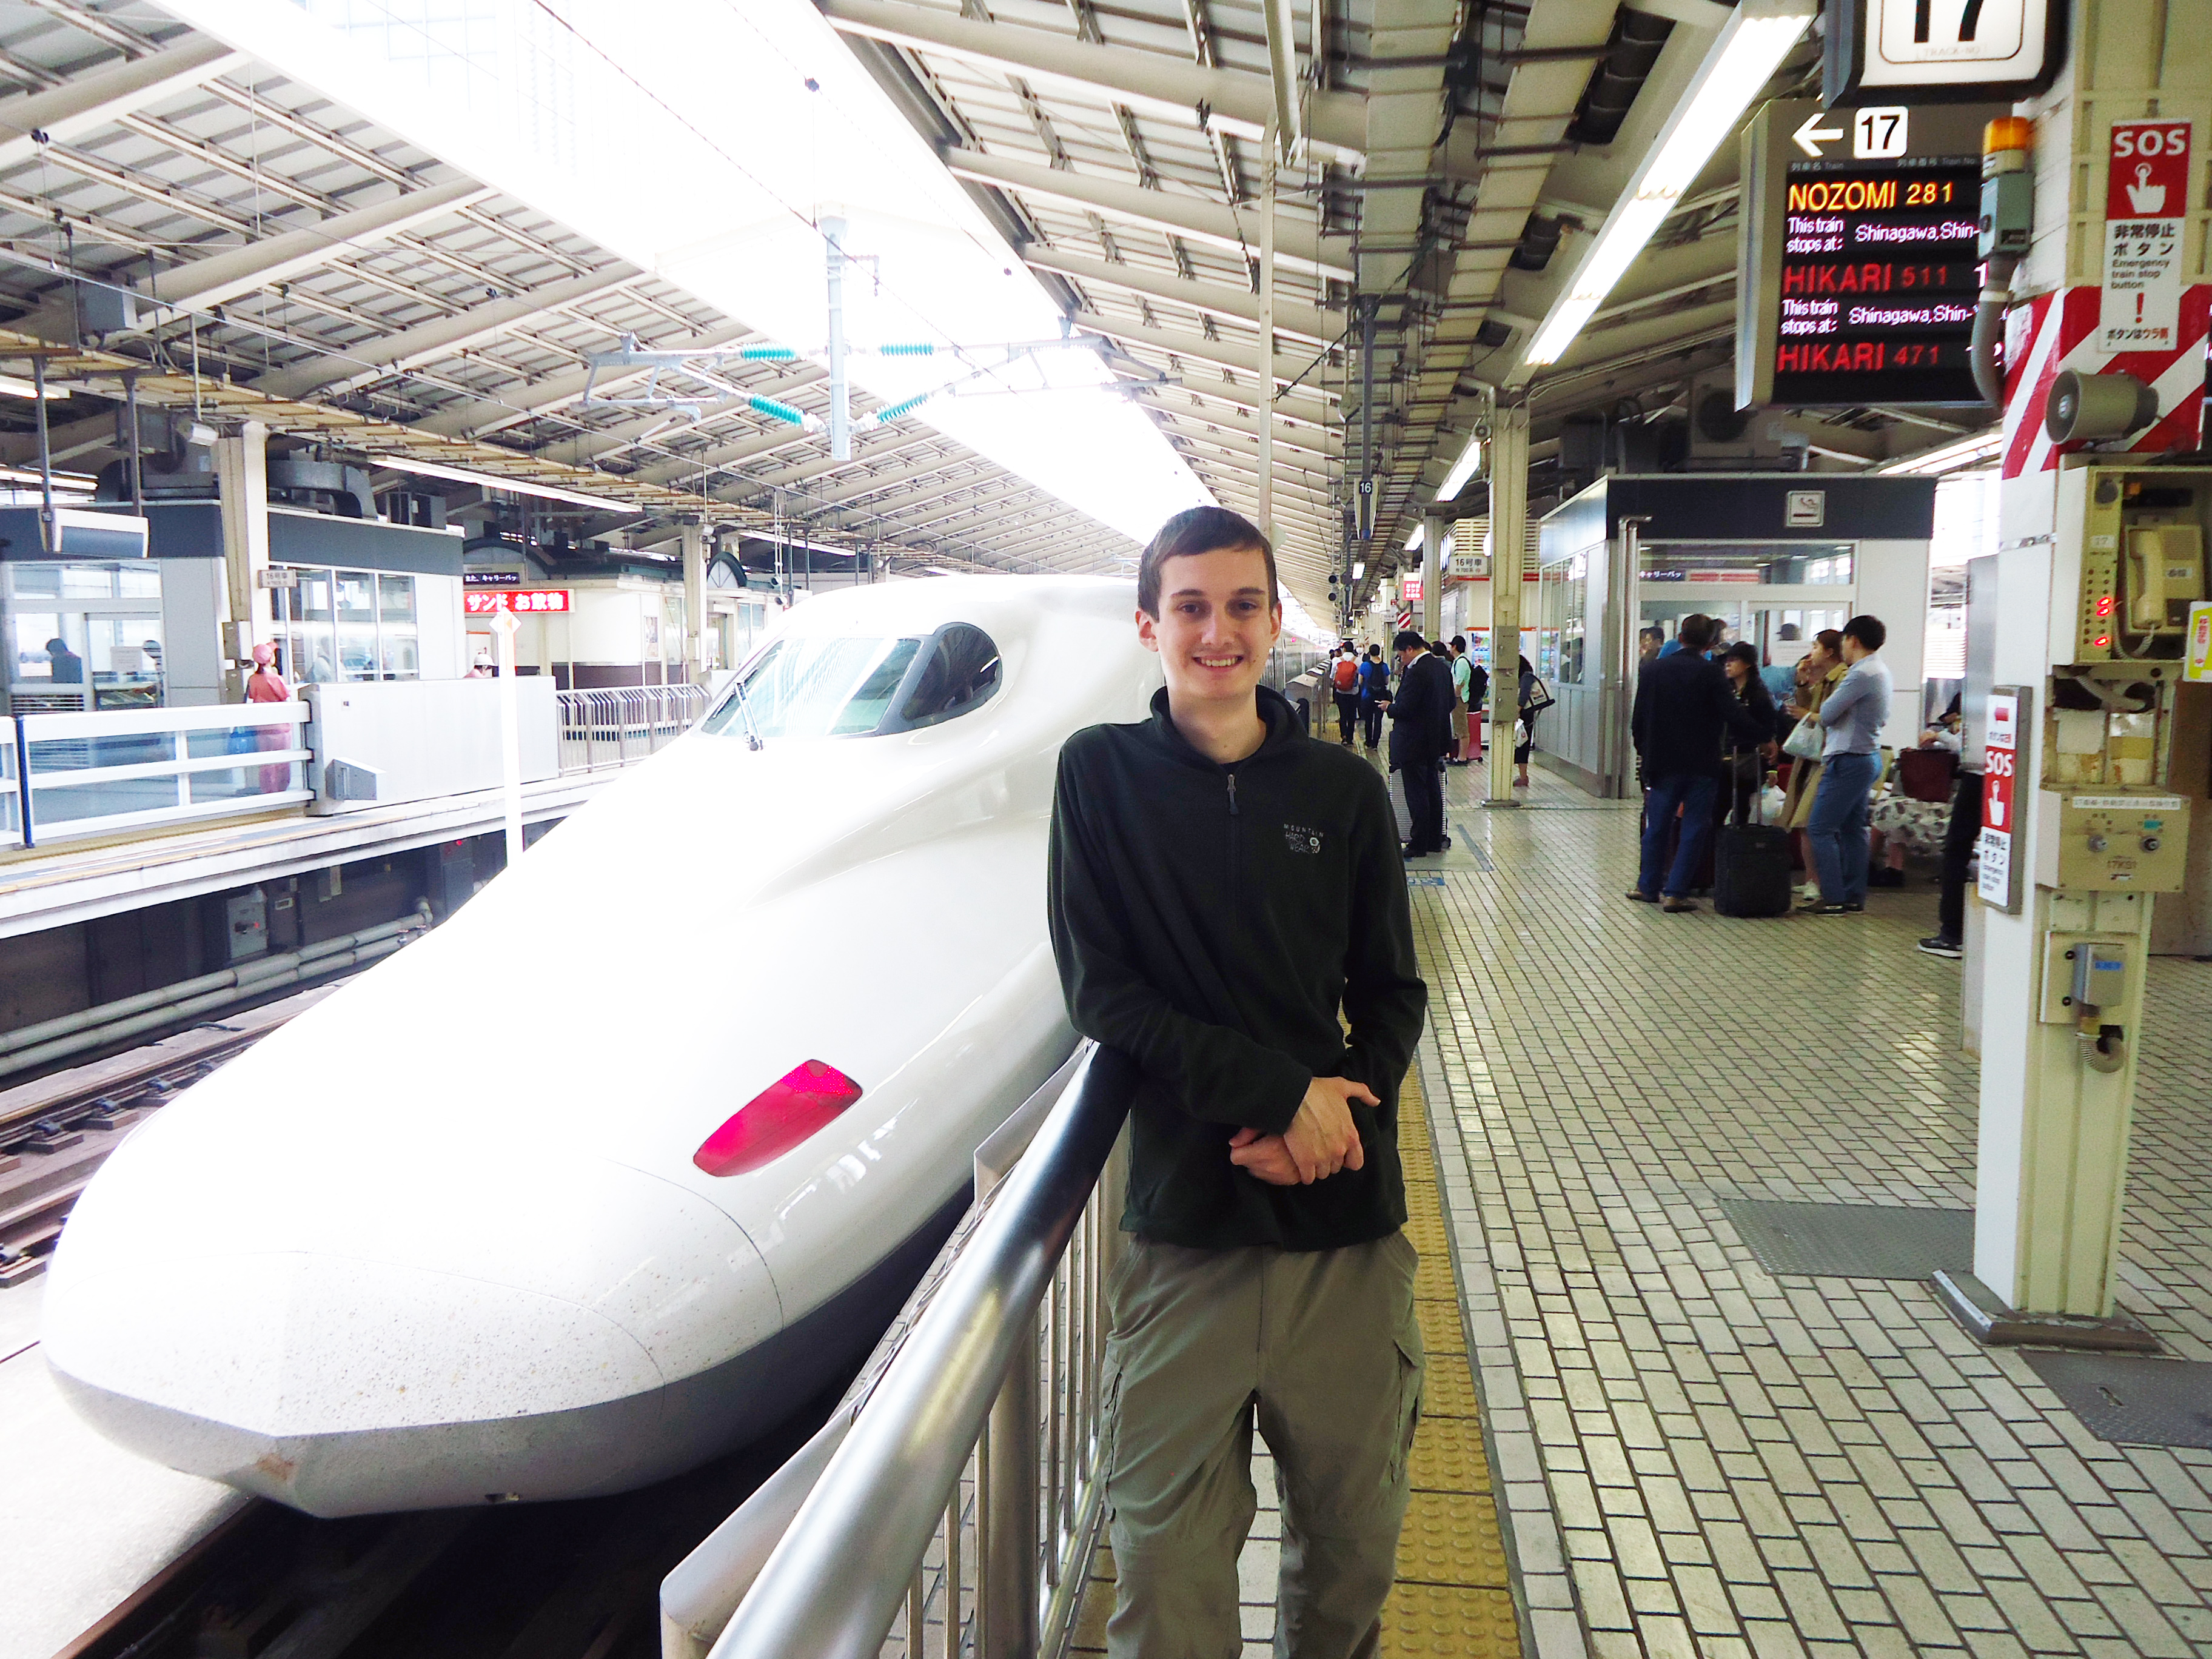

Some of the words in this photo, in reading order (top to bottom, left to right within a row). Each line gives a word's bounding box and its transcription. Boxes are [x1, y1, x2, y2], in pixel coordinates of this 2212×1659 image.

[1861, 113, 1901, 150] 17
[2114, 129, 2186, 158] SOS
[1788, 180, 1898, 212] NOZOMI
[1905, 181, 1954, 206] 281
[1786, 216, 1815, 235] This
[2114, 223, 2175, 240] 非常停止
[1786, 236, 1822, 255] stops
[1823, 235, 1844, 252] at:
[2113, 243, 2174, 256] ボタン
[2113, 258, 2171, 269] Emergency
[1783, 263, 1892, 294] HIKARI
[1900, 265, 1948, 289] 511
[2111, 270, 2136, 278] train
[2138, 270, 2161, 279] stop
[2111, 280, 2145, 290] button
[1781, 298, 1809, 317] This
[1780, 318, 1817, 337] stops
[1817, 317, 1838, 333] at:
[1776, 342, 1885, 374] HIKARI
[1893, 344, 1940, 366] 471
[1360, 482, 1372, 494] 16
[467, 592, 509, 612] サンド
[515, 592, 564, 611] お飲物
[1985, 750, 2013, 777] SOS
[1283, 823, 1324, 837] MOUNTAIN
[1285, 831, 1305, 843] HARD
